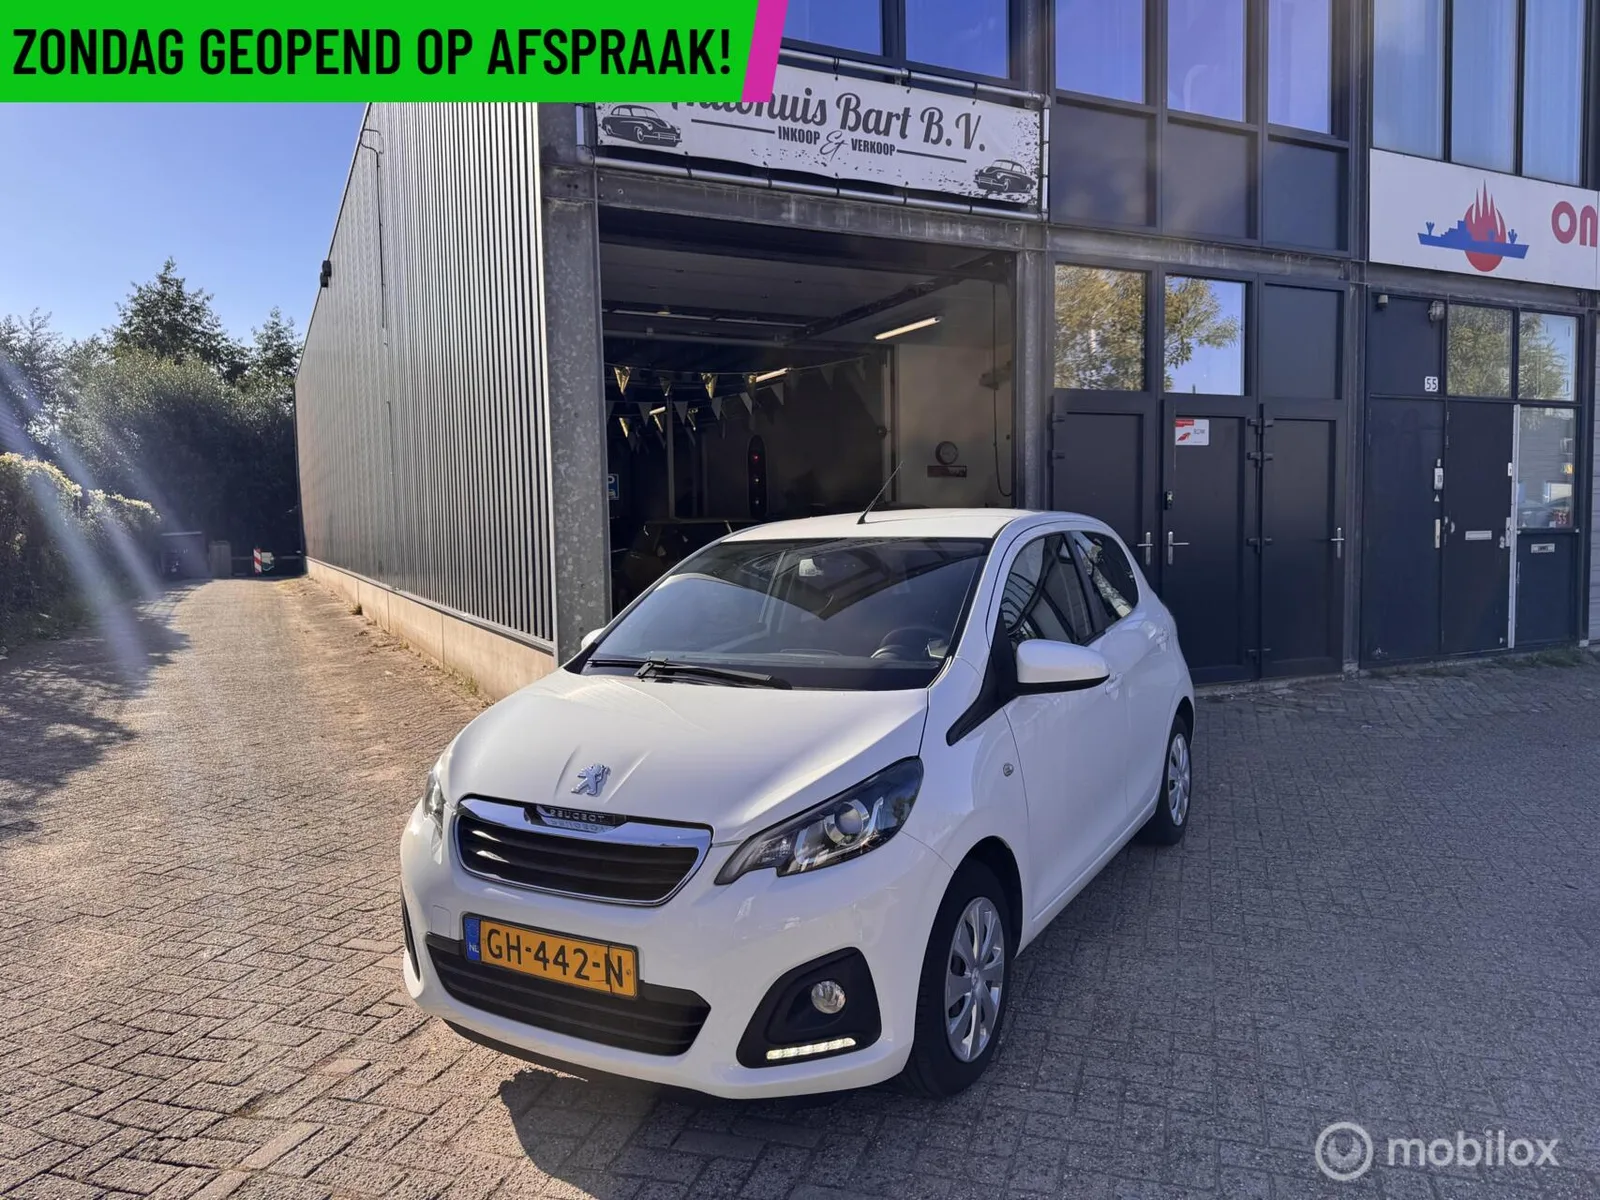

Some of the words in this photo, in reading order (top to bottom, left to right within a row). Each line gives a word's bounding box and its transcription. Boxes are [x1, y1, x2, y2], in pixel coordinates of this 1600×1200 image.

[835, 92, 912, 140] Bart
[920, 106, 986, 152] B.V.
[778, 125, 821, 145] INKOOP
[851, 137, 896, 156] VERKOOP
[1426, 377, 1436, 390] 55
[468, 942, 480, 954] NL
[487, 928, 625, 988] GH-442-N
